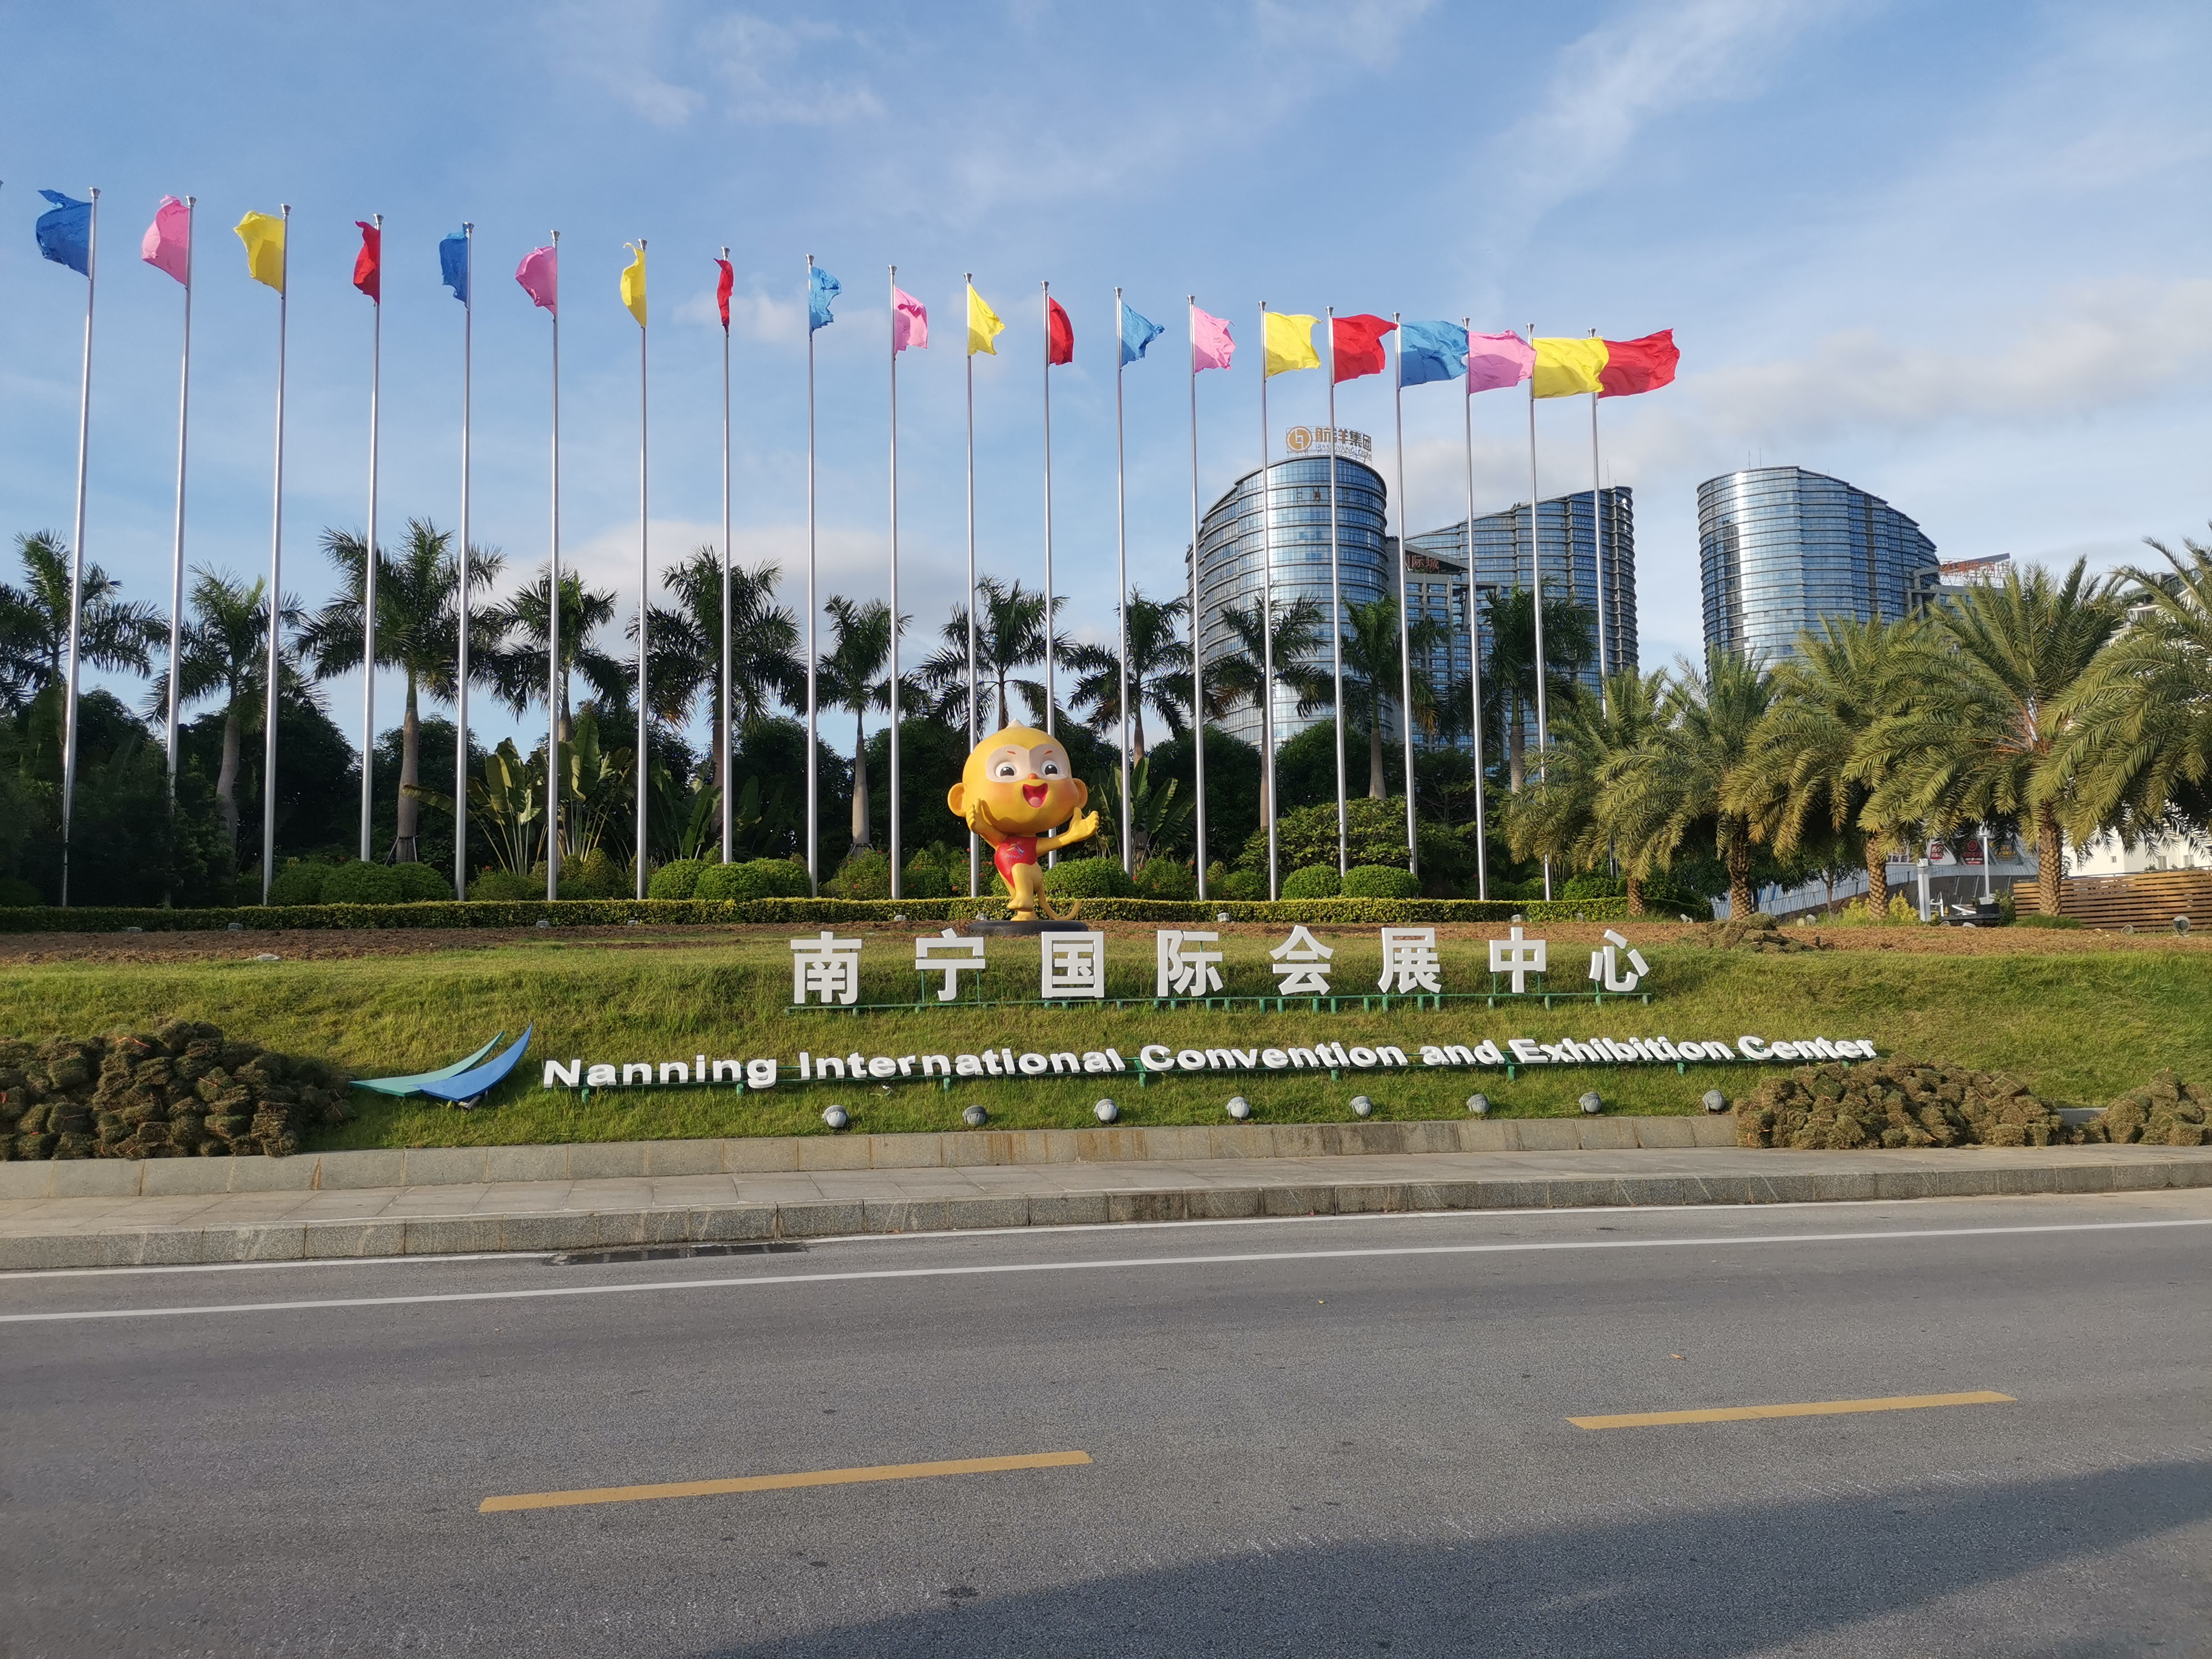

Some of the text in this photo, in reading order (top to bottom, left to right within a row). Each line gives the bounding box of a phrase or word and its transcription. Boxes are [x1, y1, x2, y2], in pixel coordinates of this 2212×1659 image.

[1316, 427, 1371, 452] 航洋集团
[1316, 442, 1355, 454] HANYANG
[791, 925, 1650, 1005] 南宁国际会展中心
[544, 1036, 1877, 1089] Nanning International Convention and Exhibition Center
